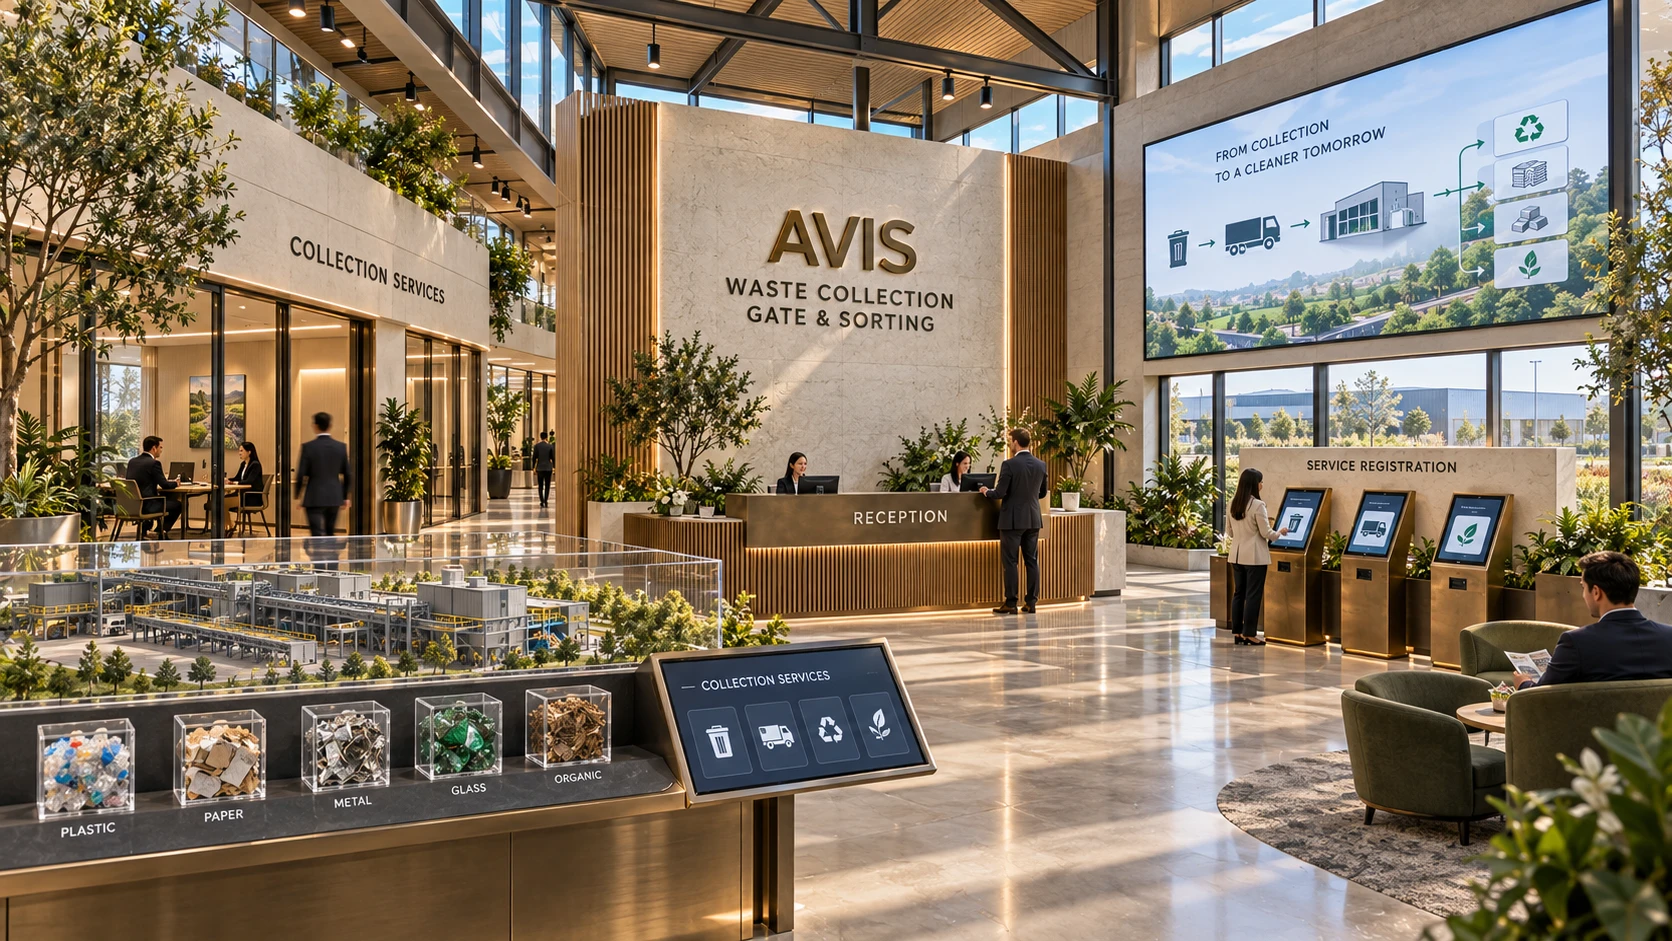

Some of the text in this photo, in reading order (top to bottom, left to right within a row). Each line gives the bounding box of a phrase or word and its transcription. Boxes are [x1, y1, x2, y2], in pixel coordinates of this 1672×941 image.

[1215, 119, 1330, 163] FROM COLLECTION
[1215, 126, 1386, 184] TO A CLEANER TOMORROW
[767, 209, 917, 275] AVIS
[289, 235, 445, 304] COLLECTION SERVICES
[725, 276, 954, 310] WASTE COLLECTION
[746, 305, 935, 332] GATE & SORTING
[1306, 459, 1458, 474] SERVICE REGISTRATION
[853, 509, 948, 525] RECEPTION
[701, 670, 831, 691] COLLECTION SERVICES
[554, 770, 602, 784] ORGANIC
[451, 783, 487, 796] GLASS
[334, 795, 372, 809] METAL
[204, 809, 244, 823] PAPER
[60, 821, 116, 838] PLASTIC
